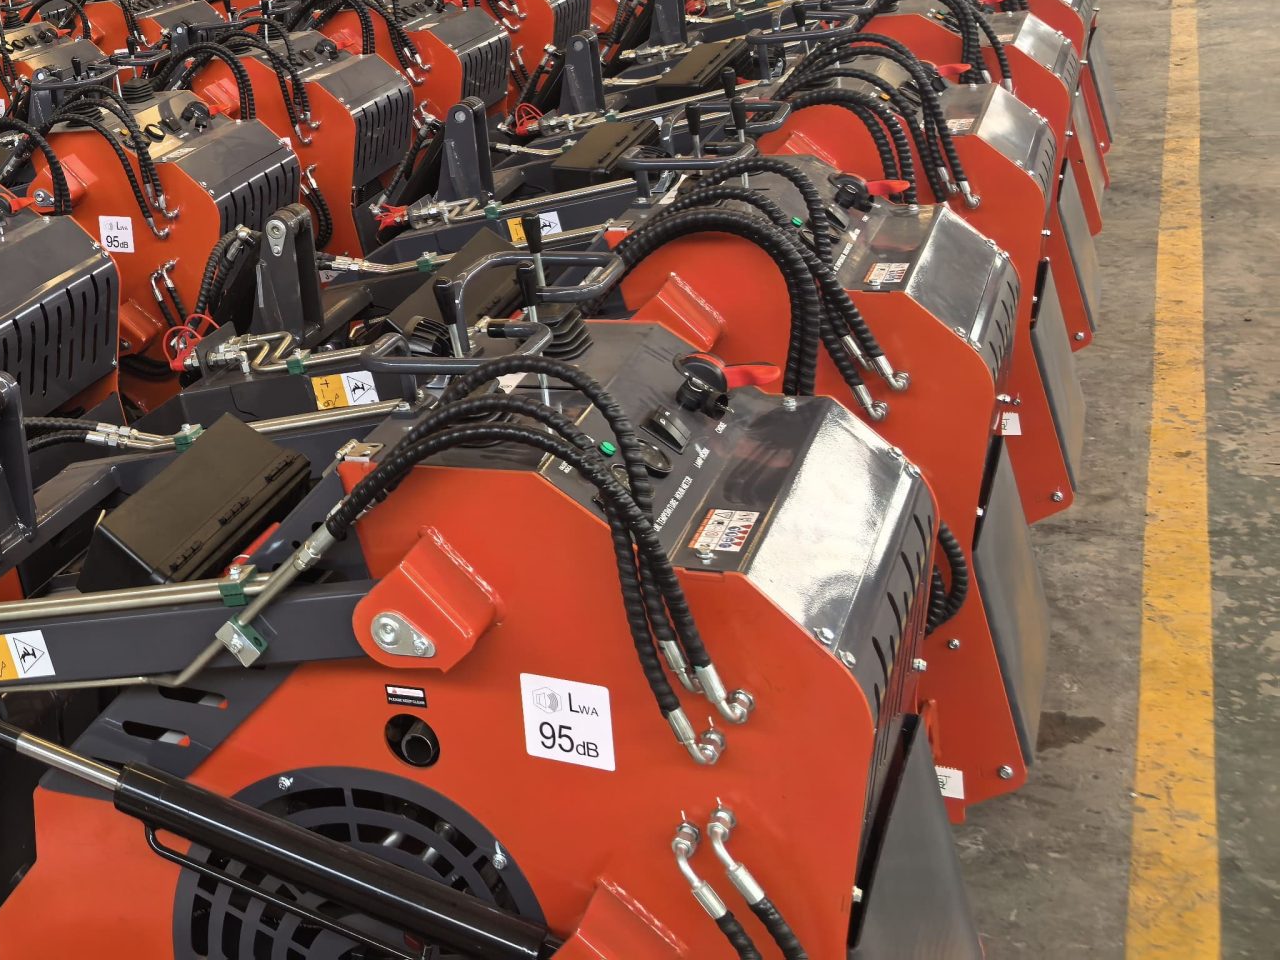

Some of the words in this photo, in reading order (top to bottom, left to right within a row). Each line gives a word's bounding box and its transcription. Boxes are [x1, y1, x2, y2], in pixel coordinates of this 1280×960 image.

[106, 235, 129, 249] 95dB
[568, 692, 599, 717] LWA
[539, 721, 600, 758] 95dB
